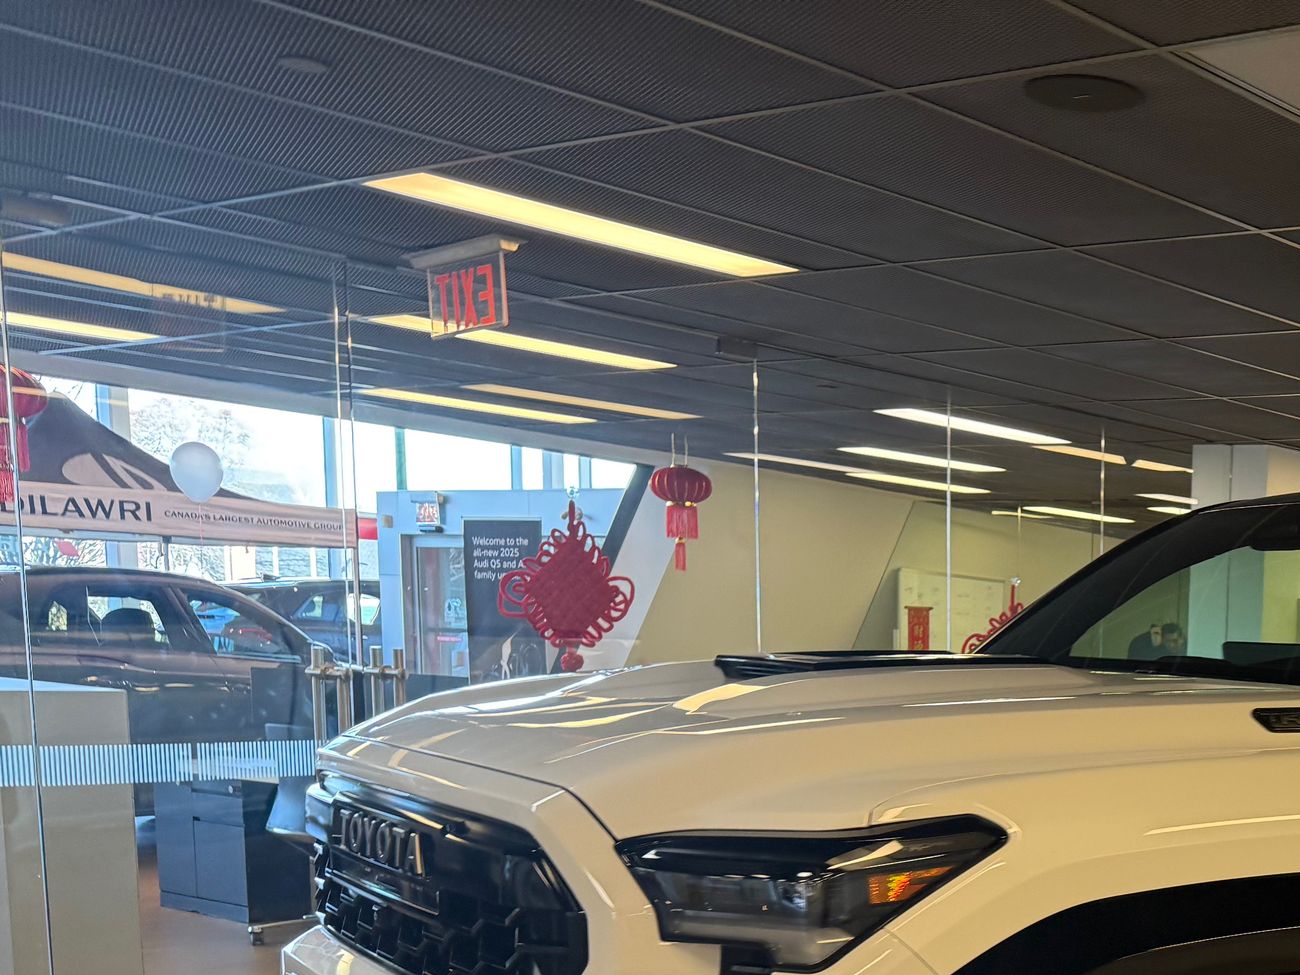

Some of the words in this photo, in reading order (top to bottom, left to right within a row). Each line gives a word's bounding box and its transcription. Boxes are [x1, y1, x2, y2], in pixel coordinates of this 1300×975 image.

[164, 509, 211, 521] CANADA'S
[213, 513, 254, 525] LARGEST
[256, 517, 312, 530] AUTOMOTIVE
[472, 536, 505, 546] Welcome
[506, 537, 515, 546] to
[516, 536, 529, 546] the
[473, 548, 499, 557] all-new
[500, 548, 520, 557] 2025
[473, 560, 489, 568] Audi
[502, 560, 517, 568] and
[474, 570, 497, 581] family
[340, 808, 425, 877] TOYOTA
